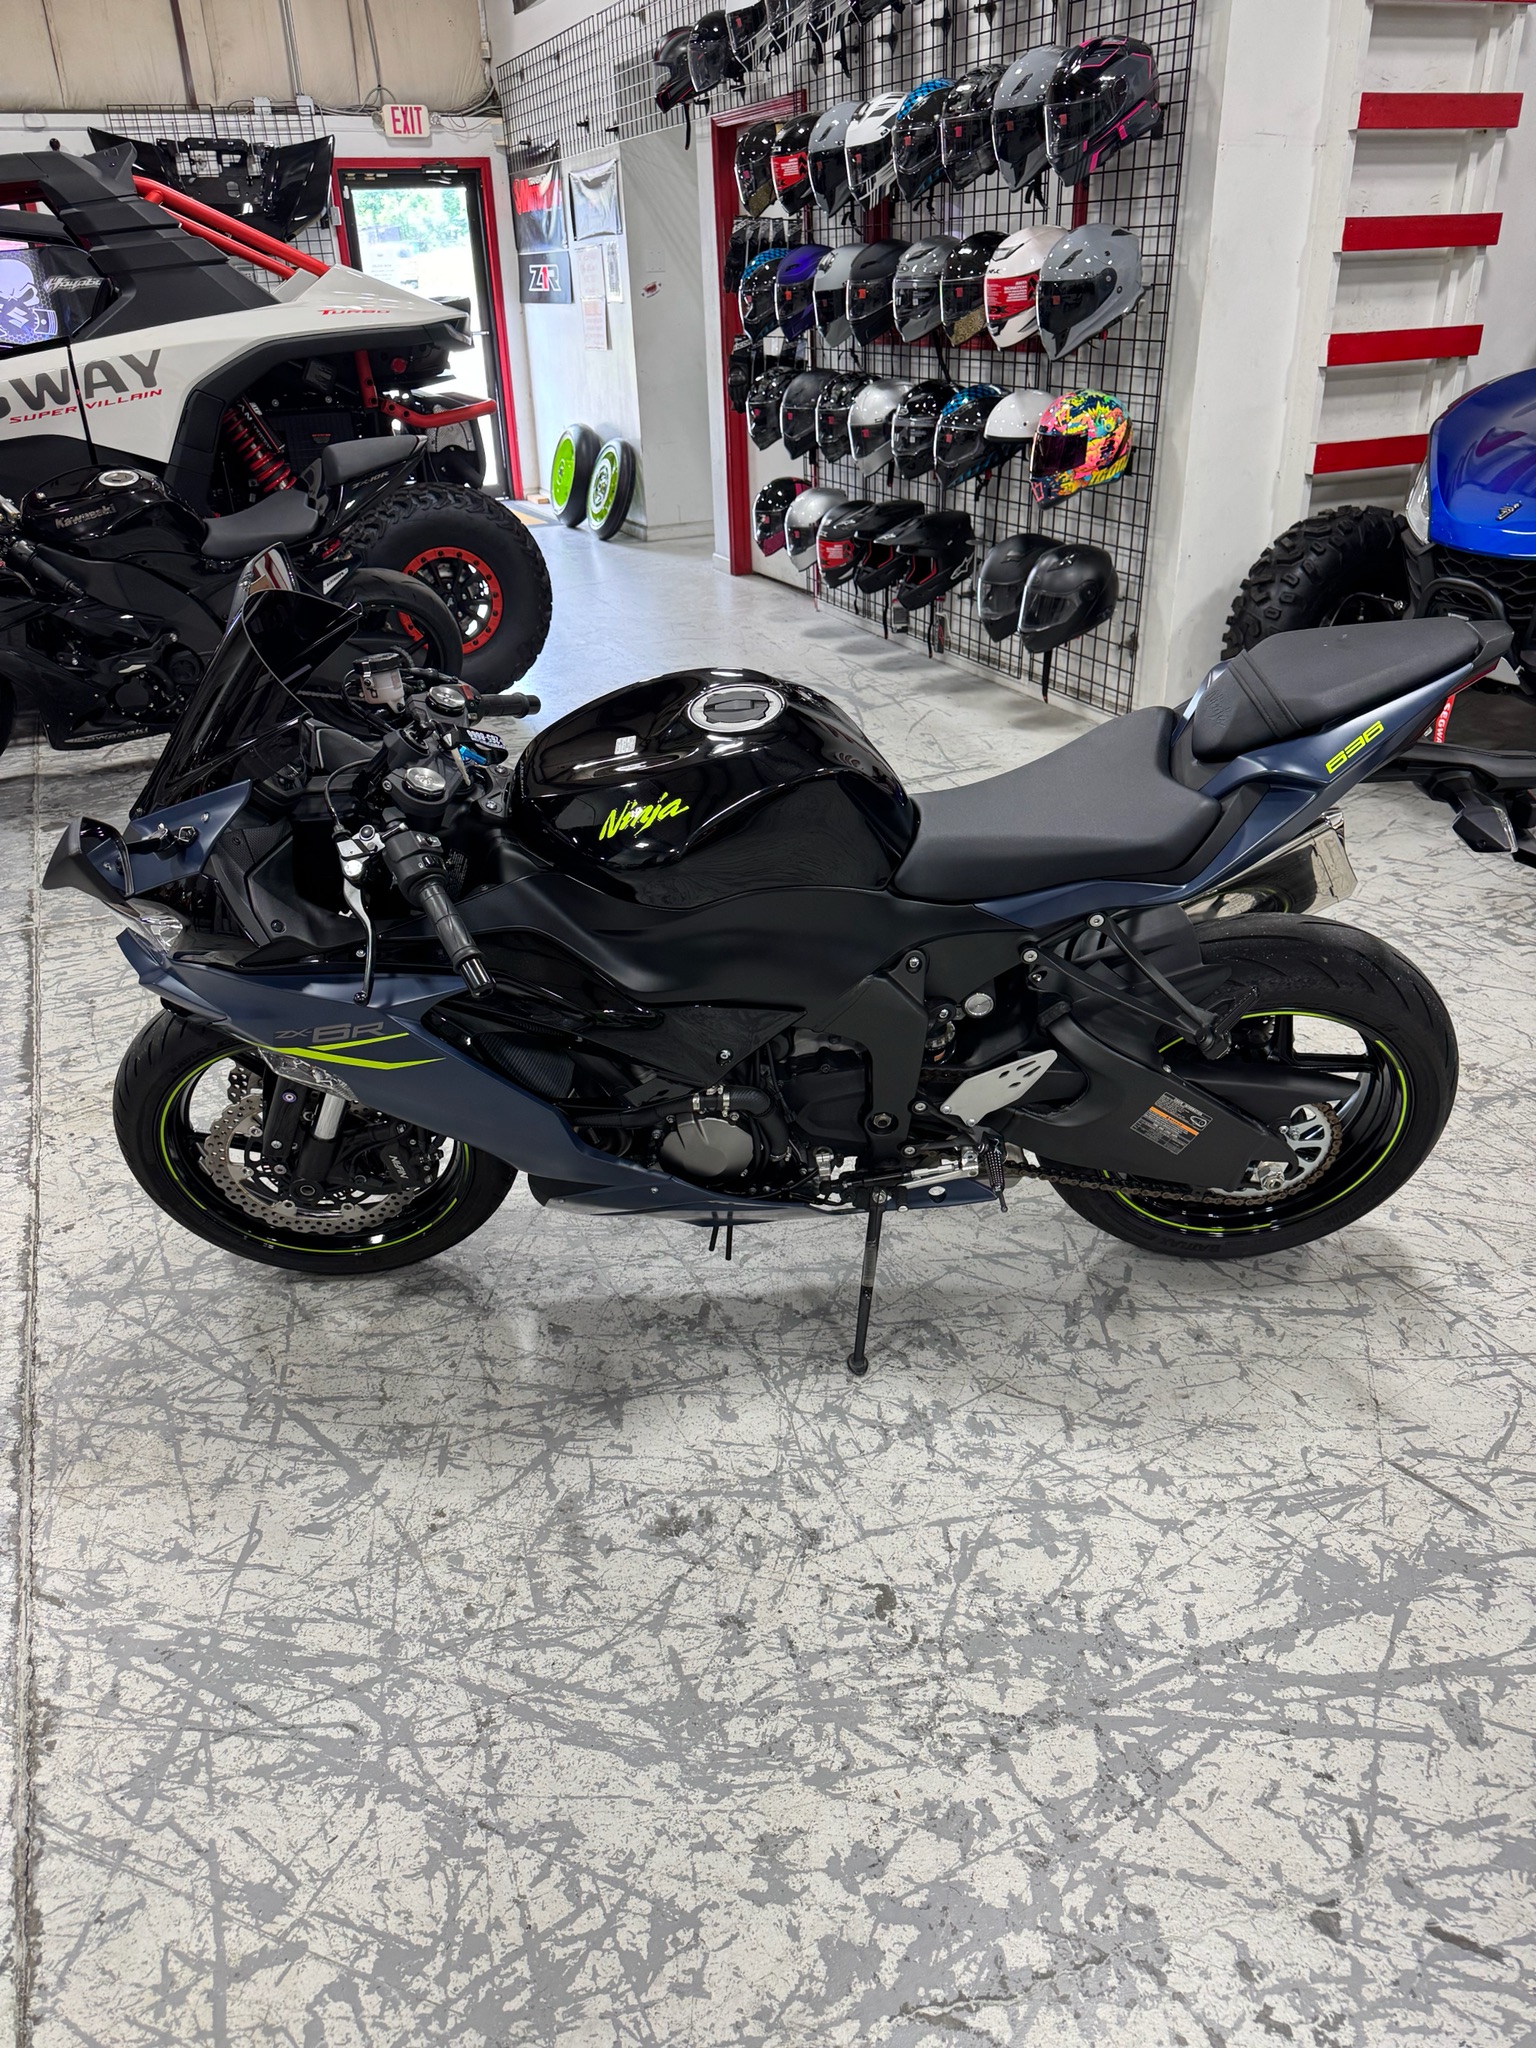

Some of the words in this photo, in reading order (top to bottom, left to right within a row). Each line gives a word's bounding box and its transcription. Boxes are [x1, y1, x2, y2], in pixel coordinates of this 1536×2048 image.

[391, 106, 423, 135] EXIT
[9, 406, 79, 424] SUPER
[85, 389, 163, 410] VILLAIN
[55, 503, 117, 529] Kawasaki
[1325, 720, 1385, 775] 636
[599, 791, 690, 841] Ninja
[275, 1021, 386, 1043] ZX-6R
